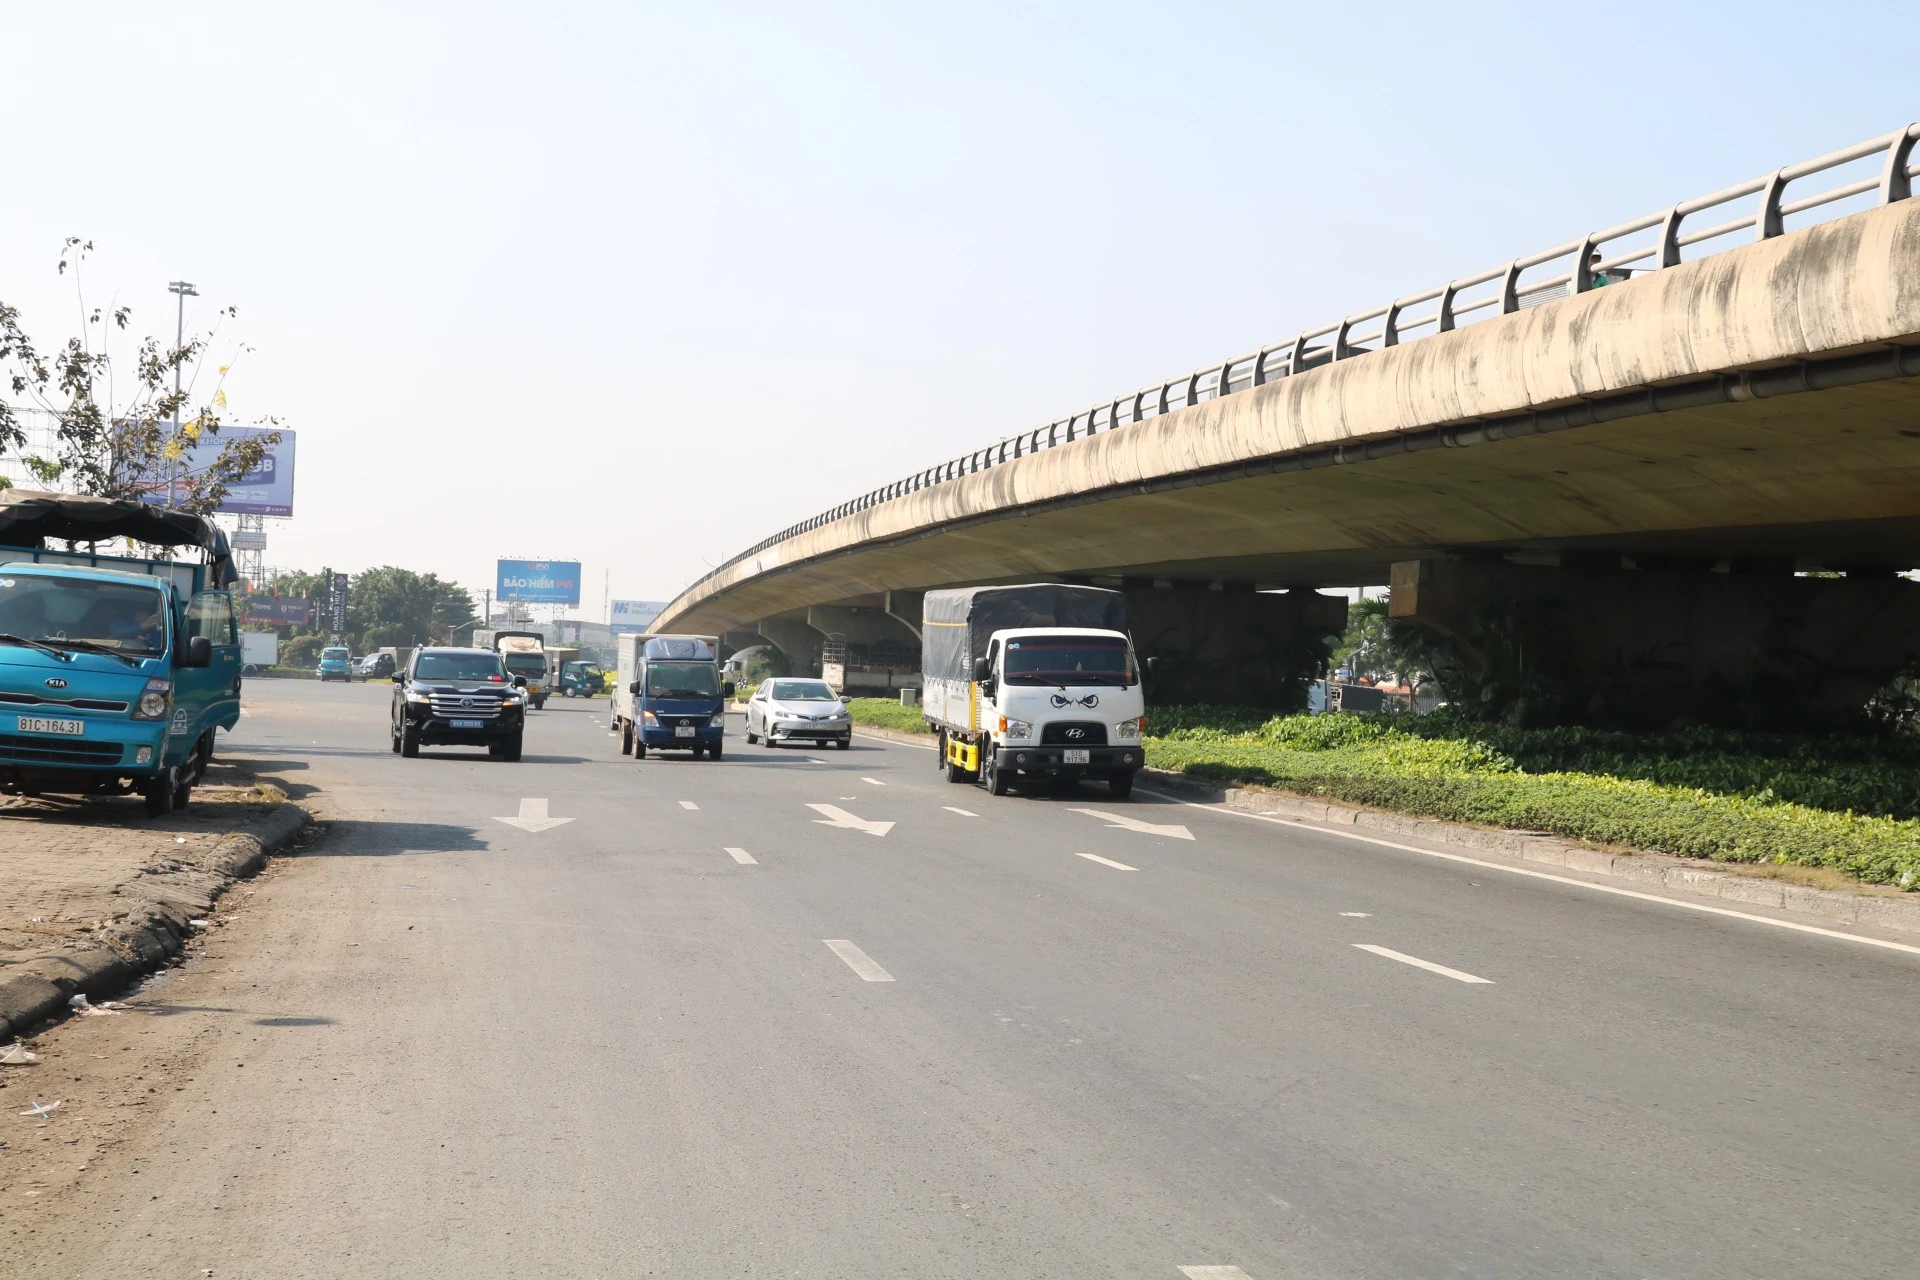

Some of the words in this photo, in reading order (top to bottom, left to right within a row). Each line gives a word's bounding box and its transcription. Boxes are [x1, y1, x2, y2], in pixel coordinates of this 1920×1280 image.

[529, 574, 554, 588] HIỂM
[48, 679, 66, 687] KIA
[20, 718, 80, 734] 81C-164.31
